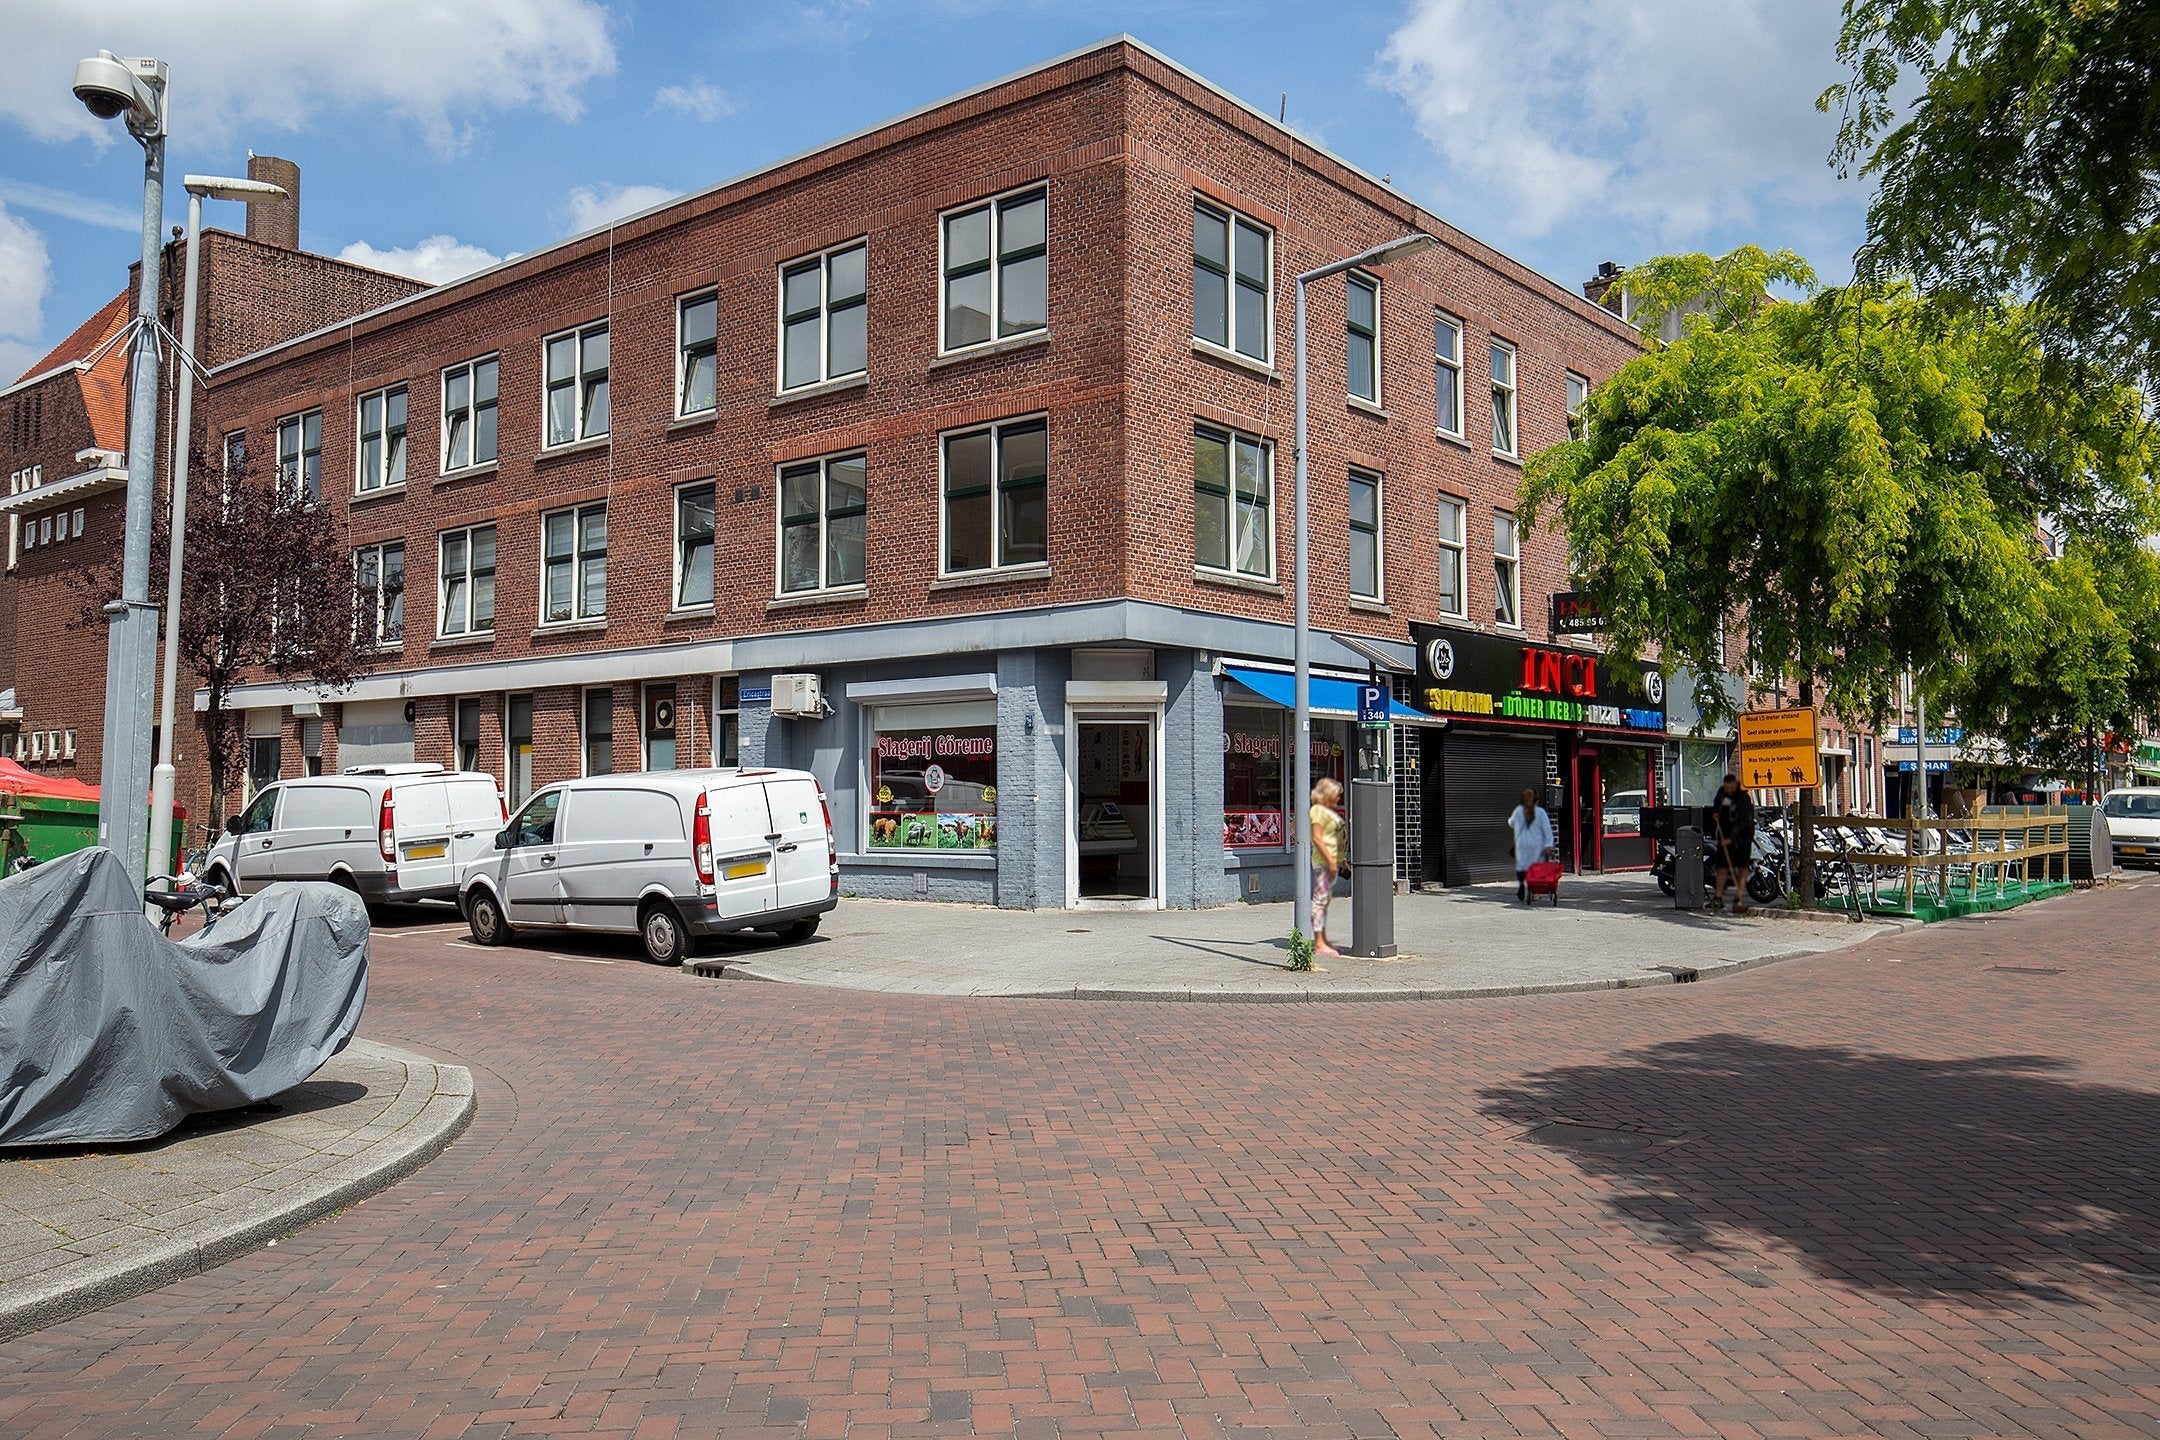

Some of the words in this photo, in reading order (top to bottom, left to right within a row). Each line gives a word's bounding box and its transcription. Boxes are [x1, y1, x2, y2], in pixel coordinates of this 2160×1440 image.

[1519, 647, 1598, 698] INCI
[743, 690, 771, 698] Ericastraa
[1365, 688, 1380, 708] P
[1367, 711, 1385, 720] 340
[1425, 688, 1494, 715] SHOARMA
[1545, 700, 1582, 722] KEBAB
[1588, 704, 1620, 726] PIZZA
[1625, 708, 1664, 730] SNACKS
[878, 736, 932, 761] Slagerij
[935, 734, 993, 755] Göreme
[1234, 732, 1280, 759] Slagerij
